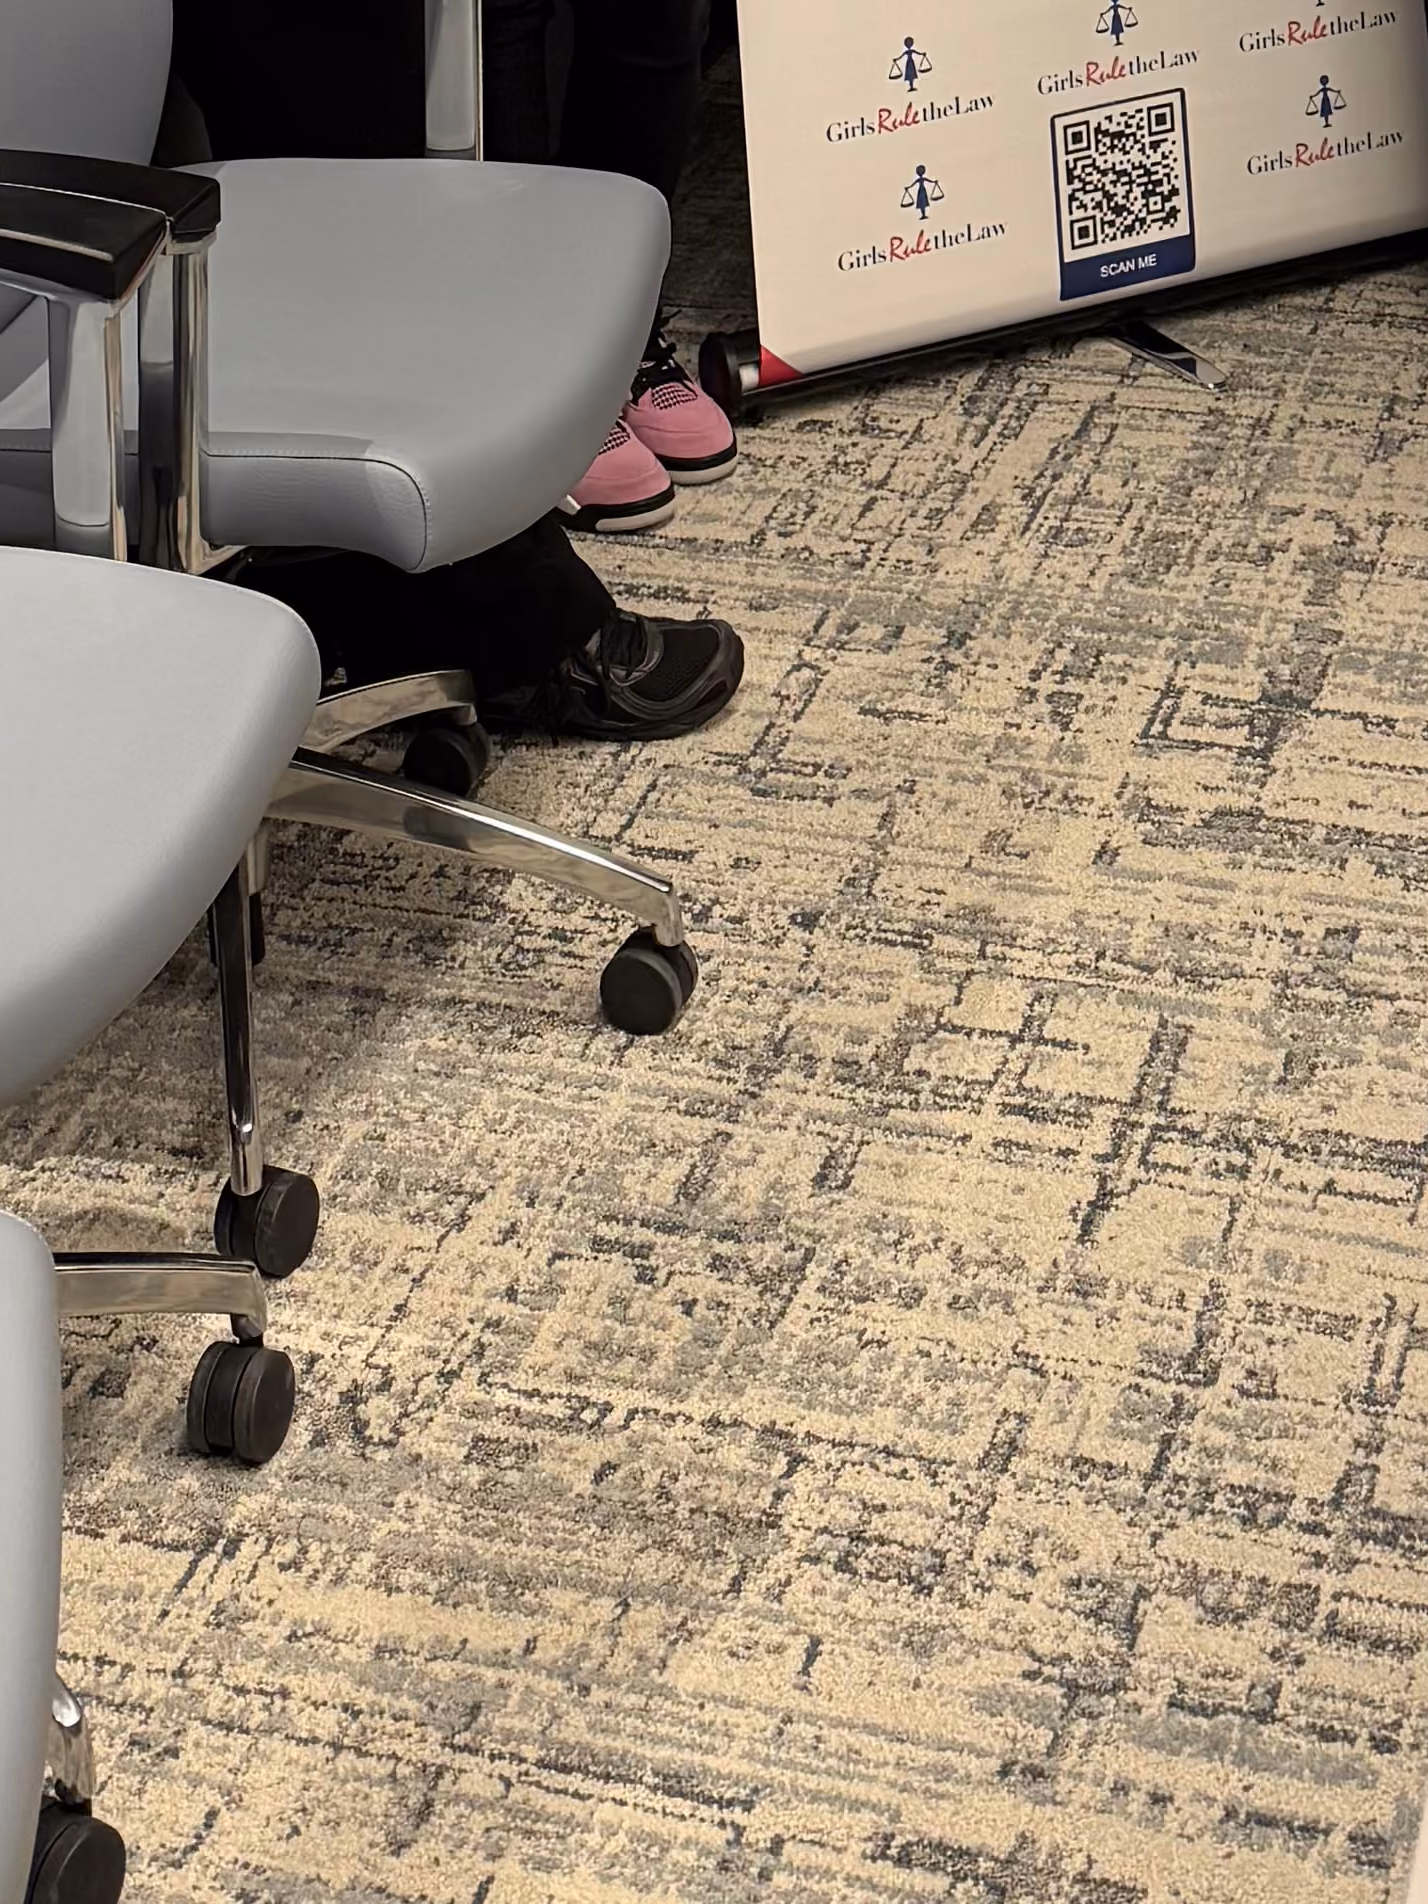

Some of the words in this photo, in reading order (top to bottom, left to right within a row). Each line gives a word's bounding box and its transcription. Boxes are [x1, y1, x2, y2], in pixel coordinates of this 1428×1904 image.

[1239, 11, 1397, 53] GirlsRuletheLaw
[1037, 50, 1199, 95] GirlsRuletheLaw
[825, 95, 995, 143] GirlsRuletheLaw
[1246, 131, 1404, 175] GirlsRuletheLaw
[837, 223, 1007, 272] GirlsRuletheLaw
[1100, 258, 1135, 278] SCAN
[1138, 253, 1157, 269] ME
